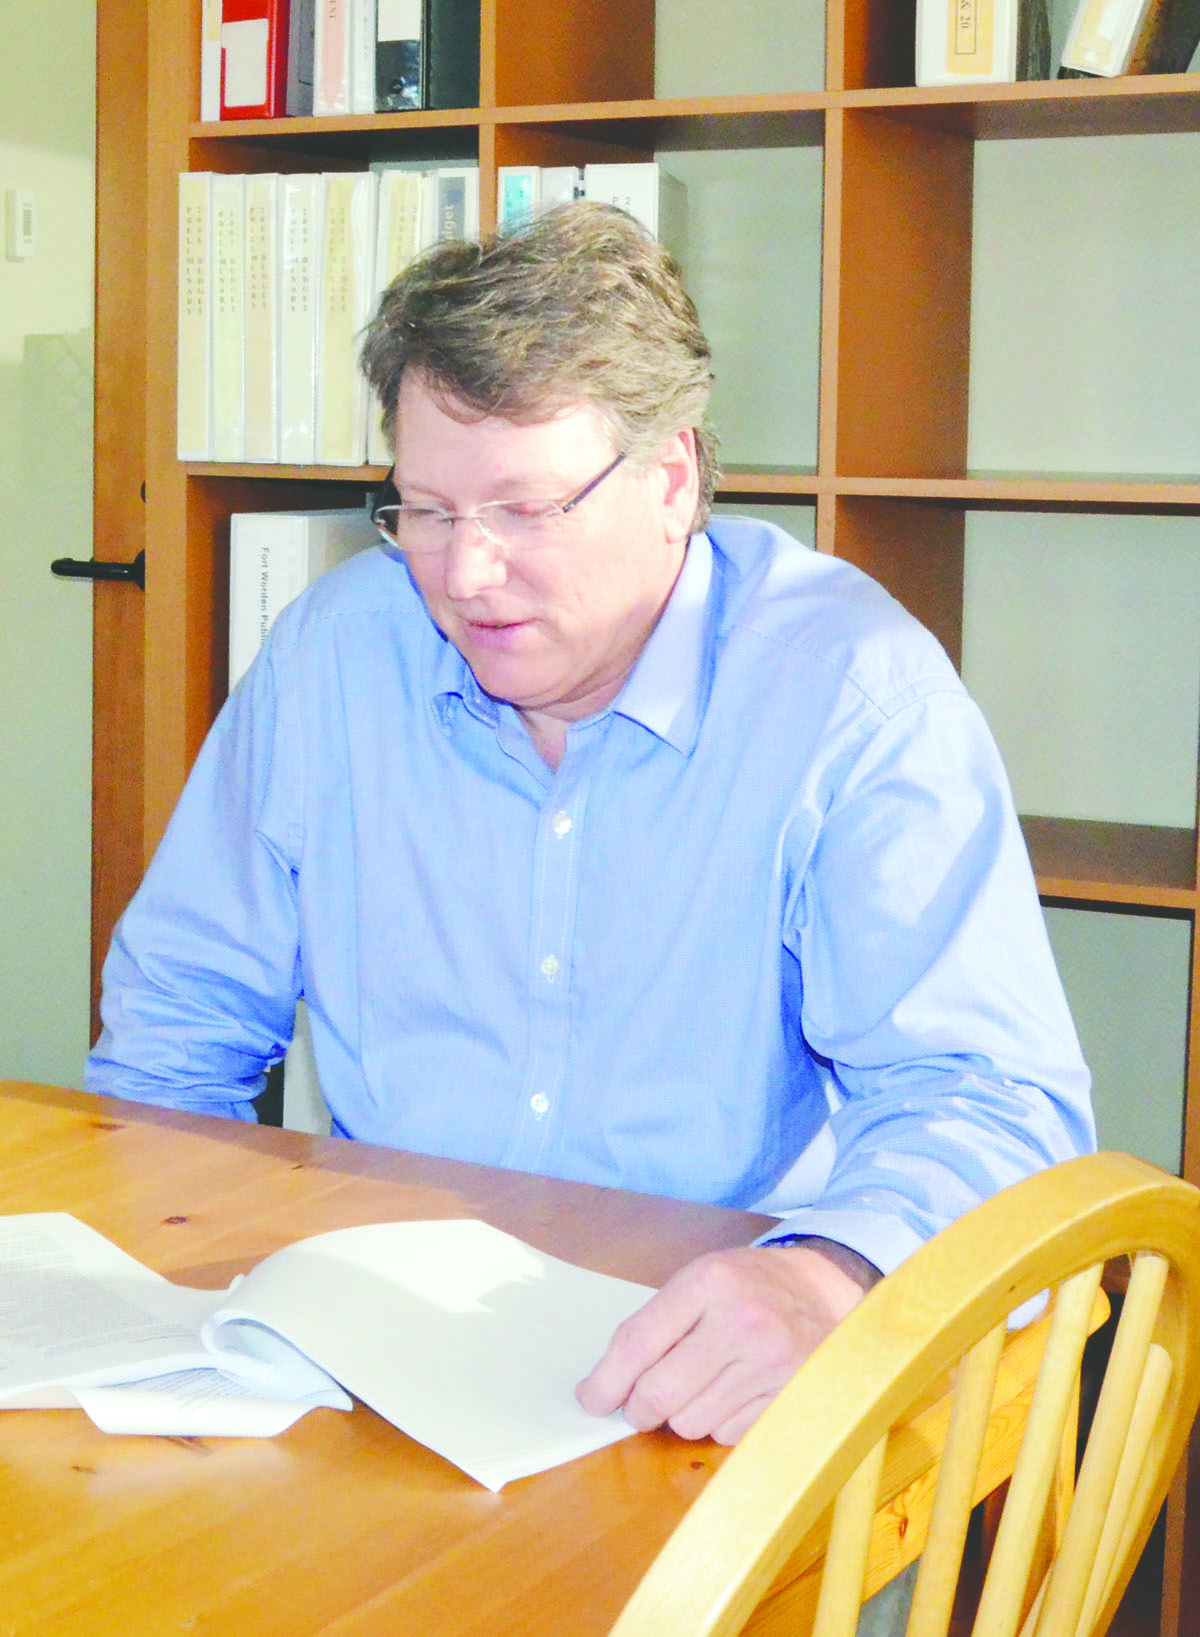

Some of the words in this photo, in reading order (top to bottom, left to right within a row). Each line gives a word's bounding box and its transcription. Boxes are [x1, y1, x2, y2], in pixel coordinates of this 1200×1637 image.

[186, 206, 194, 316] PRELIMINARY
[218, 210, 226, 313] PRELIMINARY
[250, 206, 258, 309] PRELIMINARY
[260, 571, 270, 612] Worden
[261, 547, 270, 568] Fort
